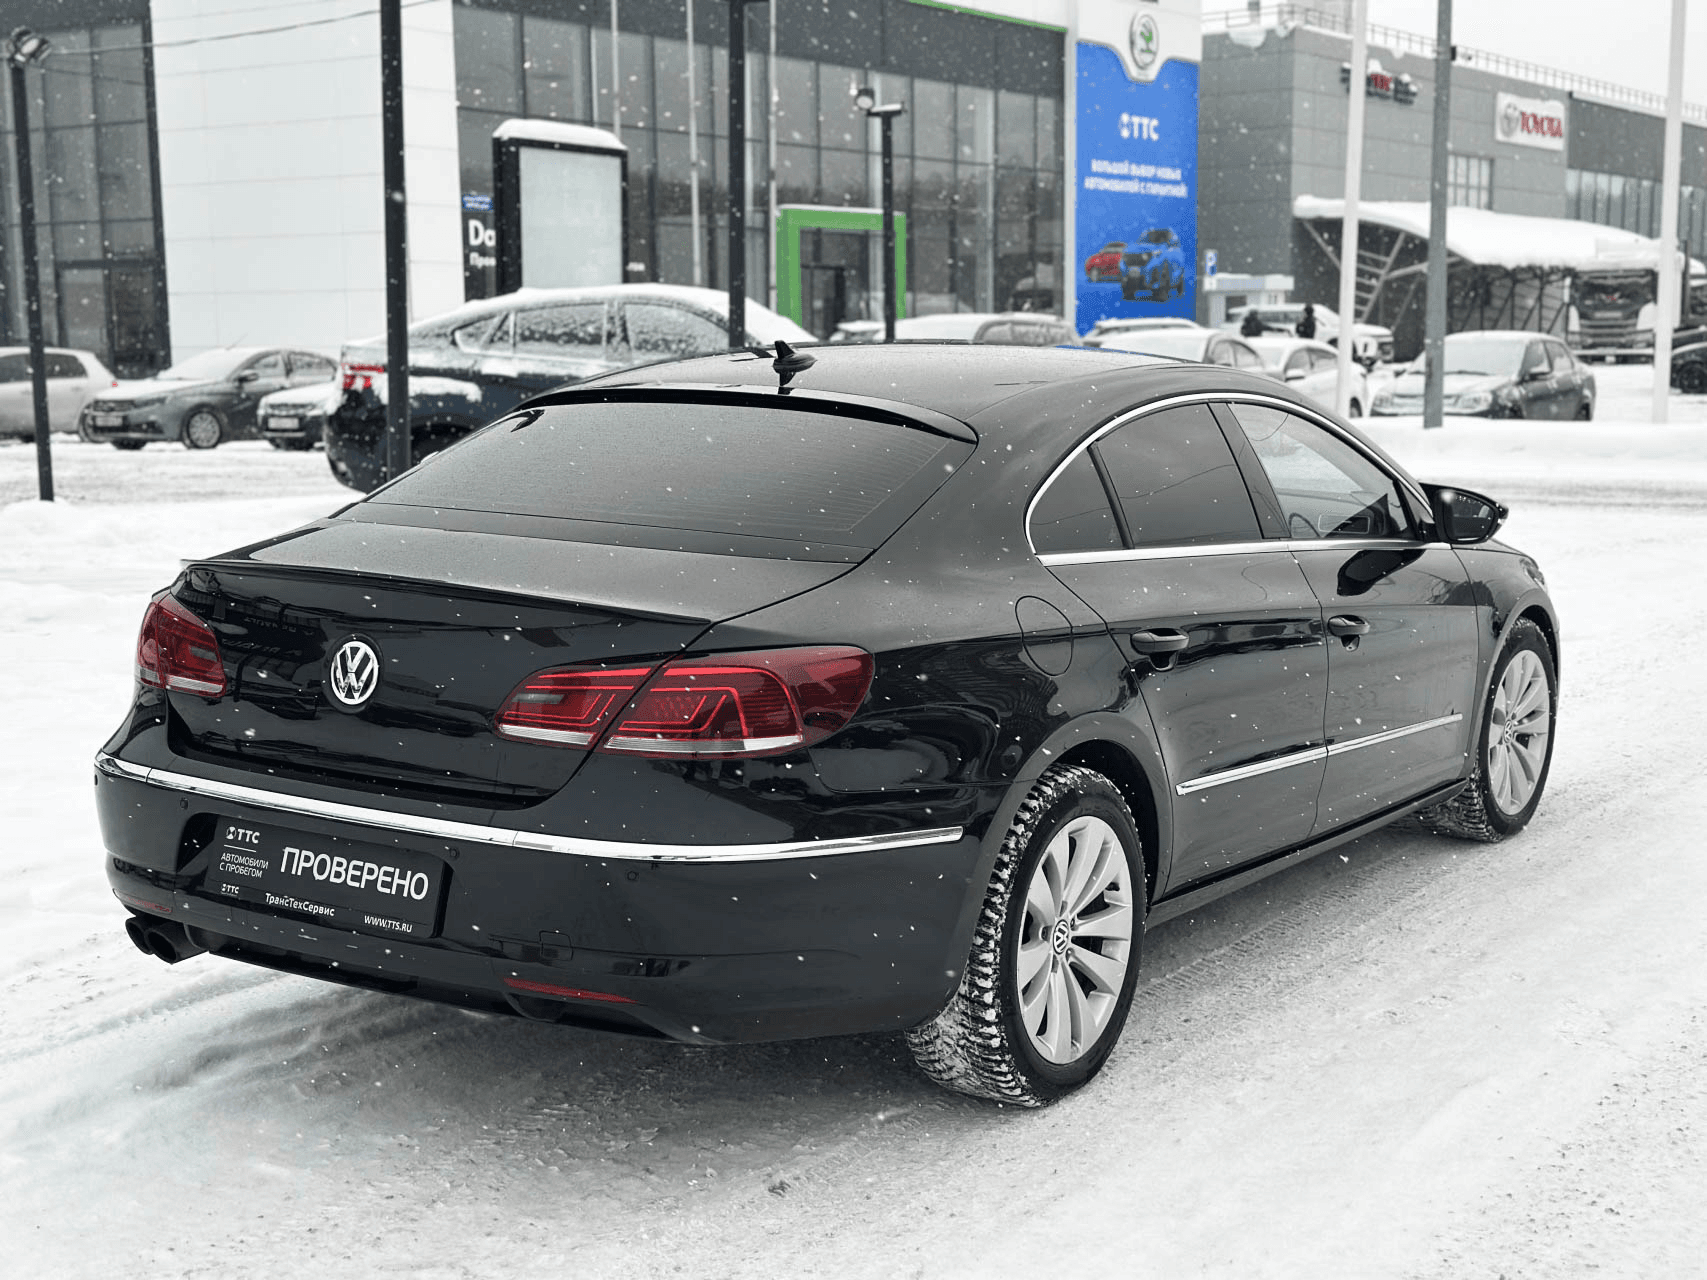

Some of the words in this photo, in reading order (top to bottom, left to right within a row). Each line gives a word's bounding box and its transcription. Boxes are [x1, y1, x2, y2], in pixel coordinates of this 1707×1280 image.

[1131, 115, 1159, 141] ТТС
[1521, 112, 1563, 137] TOYOTA
[237, 828, 261, 844] ТТС
[219, 862, 226, 871] С
[225, 863, 263, 878] ПРОБЕГОМ
[220, 852, 269, 870] АВТОМОБИЛИ
[280, 846, 429, 901] ПРОВЕРЕНО
[265, 892, 335, 917] ТрансТехСервис
[364, 914, 413, 933] WWW.TTS.RU
